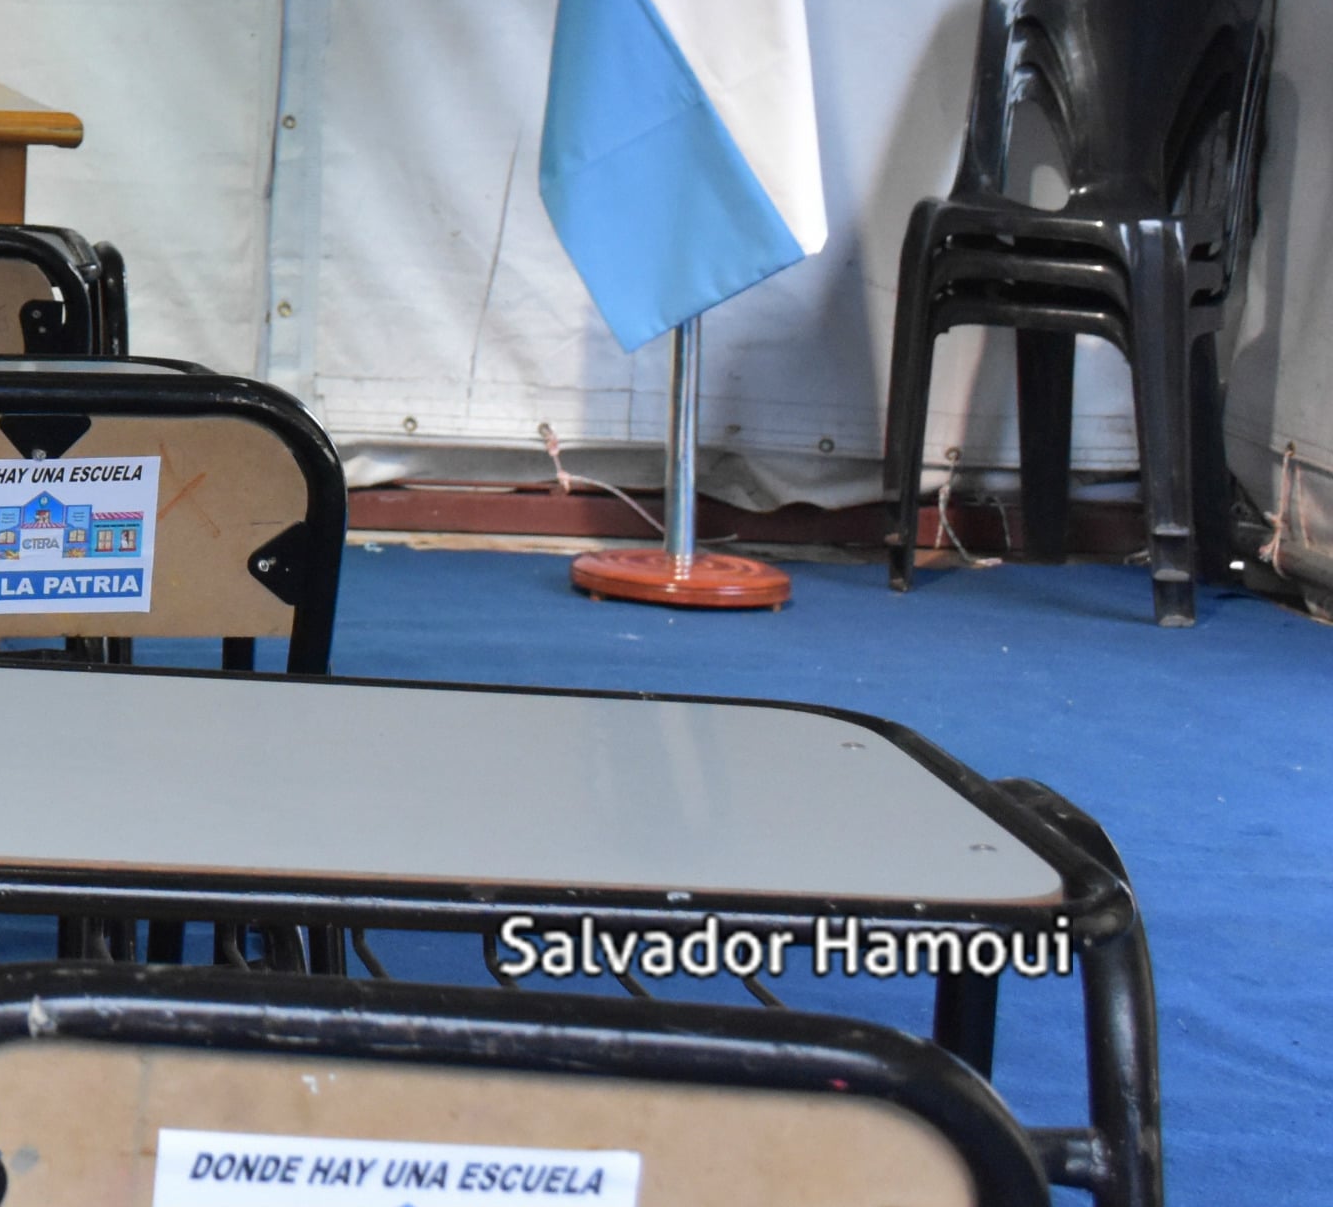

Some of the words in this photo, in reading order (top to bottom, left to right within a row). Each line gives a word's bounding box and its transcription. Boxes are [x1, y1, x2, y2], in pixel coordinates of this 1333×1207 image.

[32, 466, 64, 483] UNA
[69, 465, 143, 482] ESCUELA
[22, 537, 60, 550] CTERA
[0, 577, 34, 596] LA
[44, 575, 139, 595] PATRIA
[190, 1152, 302, 1184] DONDE
[308, 1157, 378, 1188] HAY
[381, 1159, 451, 1190] UNA
[458, 1163, 604, 1195] ESCUELA
